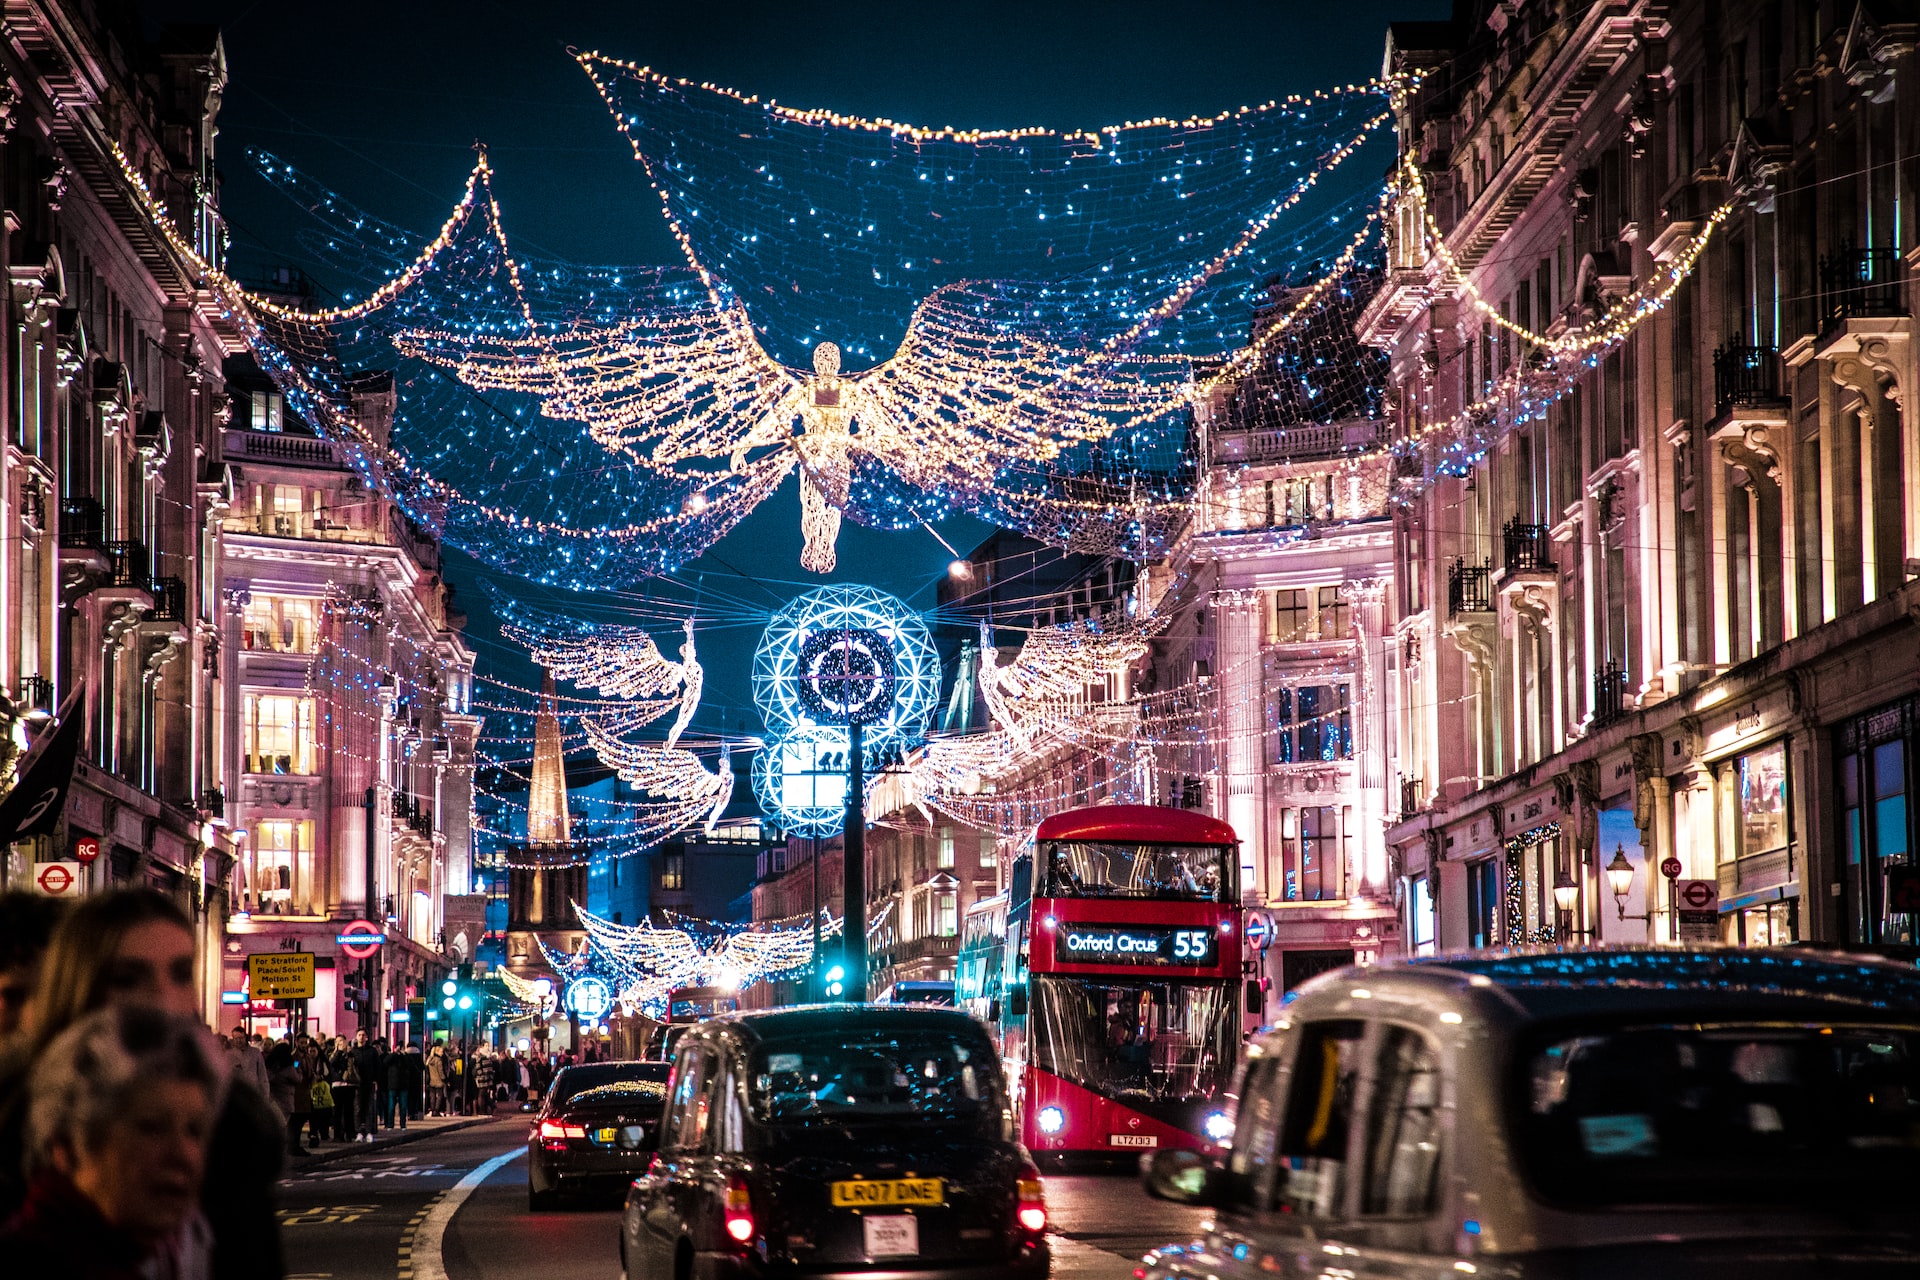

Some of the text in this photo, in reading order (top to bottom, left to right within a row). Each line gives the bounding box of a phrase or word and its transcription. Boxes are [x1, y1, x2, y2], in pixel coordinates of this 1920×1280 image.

[78, 844, 96, 855] RC
[1663, 863, 1680, 873] RG
[1067, 931, 1207, 957] Oxford Circus 55
[270, 956, 308, 965] Stratford
[257, 966, 306, 974] Place/South
[840, 1182, 934, 1202] LR07 DNE
